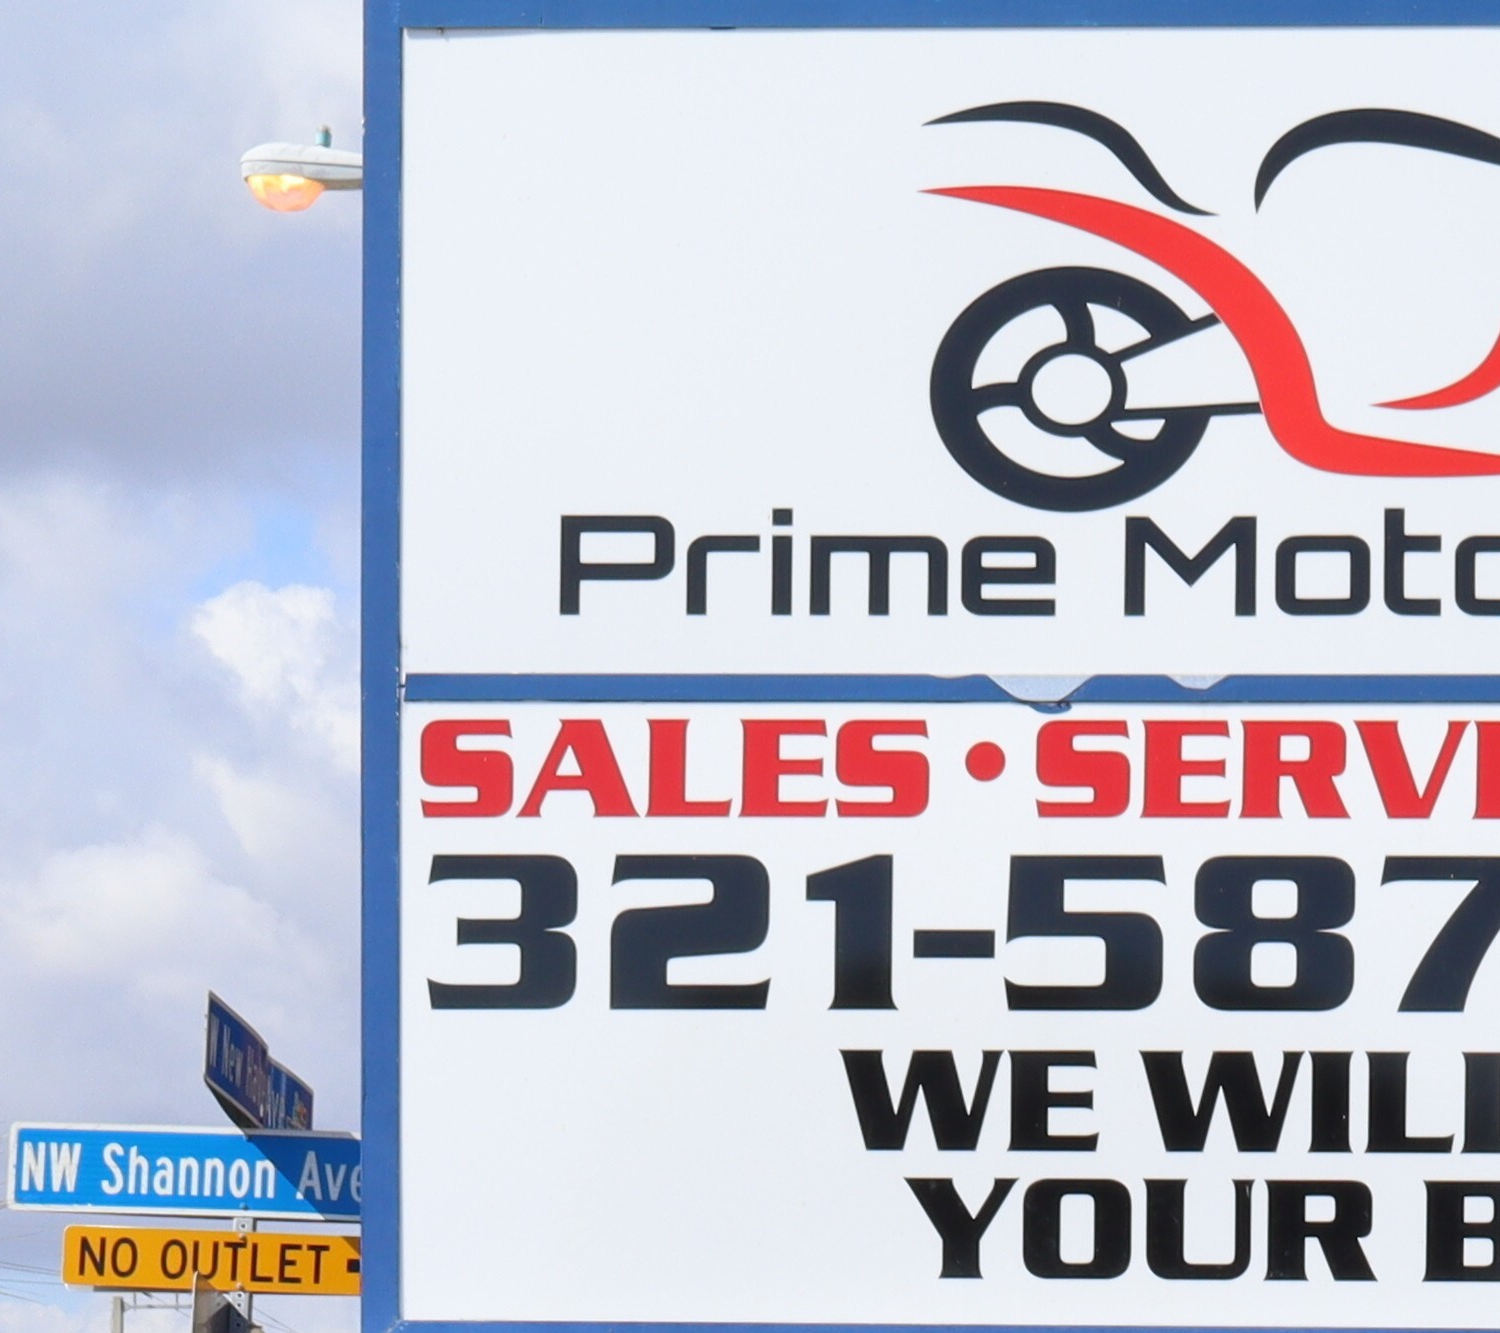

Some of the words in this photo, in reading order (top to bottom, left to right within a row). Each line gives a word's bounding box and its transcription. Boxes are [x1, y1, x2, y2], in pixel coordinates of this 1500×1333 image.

[560, 507, 1056, 618] Prime
[421, 720, 929, 817] SALES
[841, 1050, 1098, 1151] WE
[20, 1141, 81, 1193] NW
[101, 1142, 276, 1200] Shannon
[78, 1236, 138, 1278] NO
[160, 1238, 330, 1284] OUTLET
[905, 1178, 1376, 1281] YOUR
